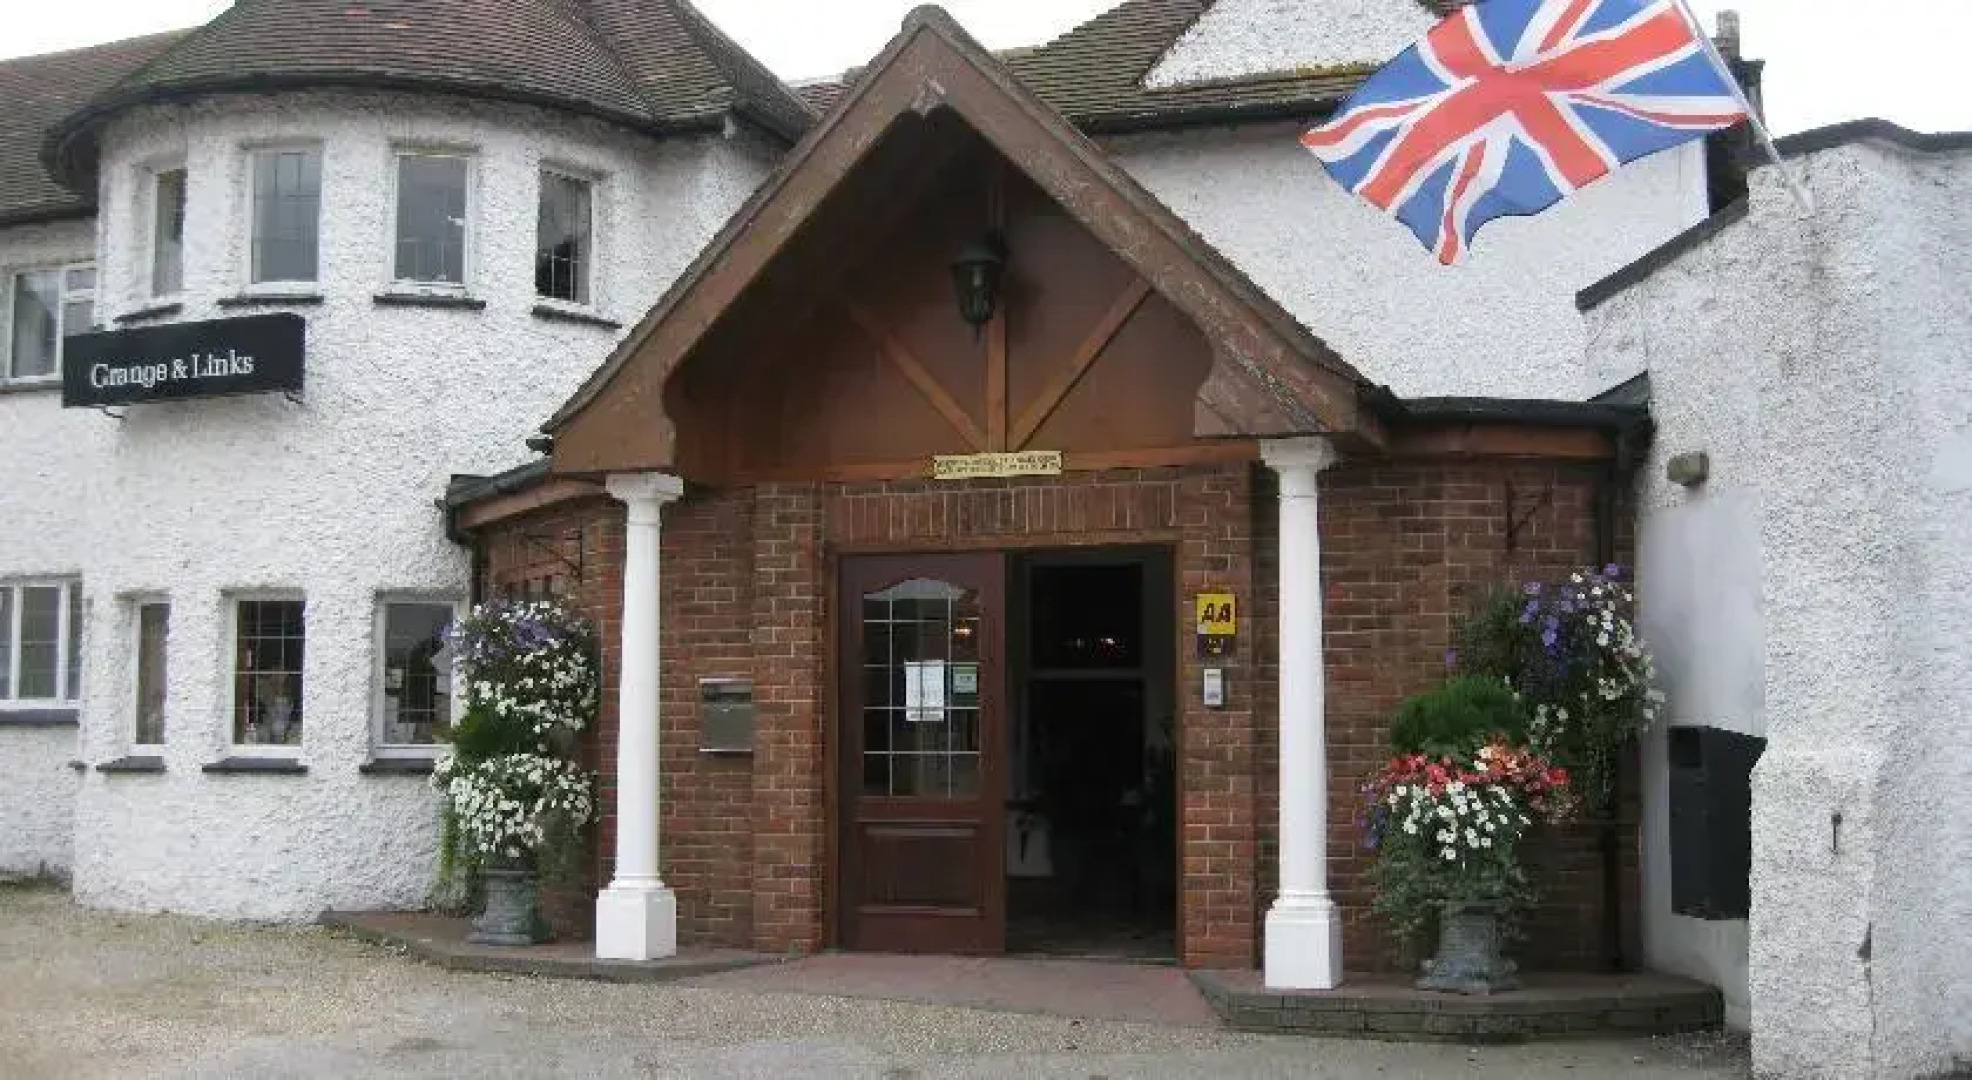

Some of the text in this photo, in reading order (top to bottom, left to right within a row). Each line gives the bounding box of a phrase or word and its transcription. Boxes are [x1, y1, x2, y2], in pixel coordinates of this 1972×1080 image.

[91, 350, 255, 388] Grange & Links
[1201, 603, 1231, 623] AA
